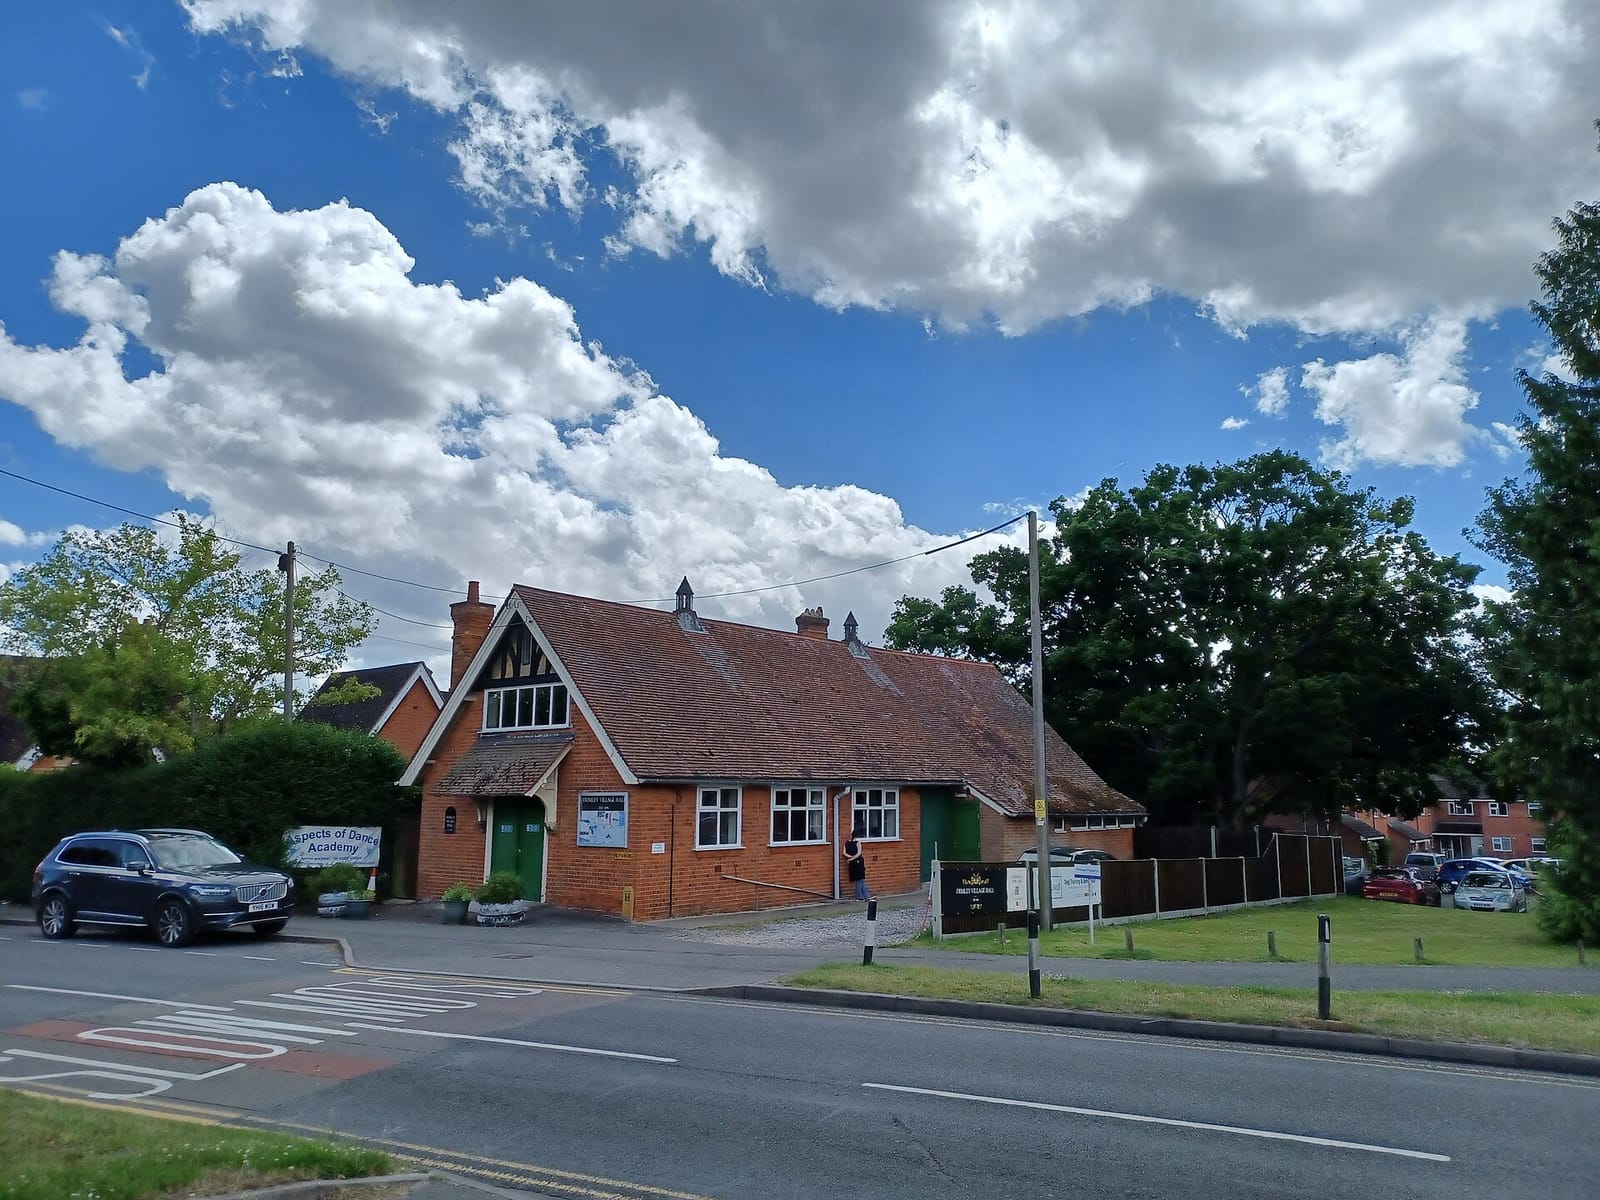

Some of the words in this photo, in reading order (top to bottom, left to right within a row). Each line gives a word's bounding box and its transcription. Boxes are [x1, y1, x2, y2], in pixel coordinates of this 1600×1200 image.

[335, 829, 346, 839] of
[349, 829, 379, 846] Dance
[308, 841, 359, 855] Academy
